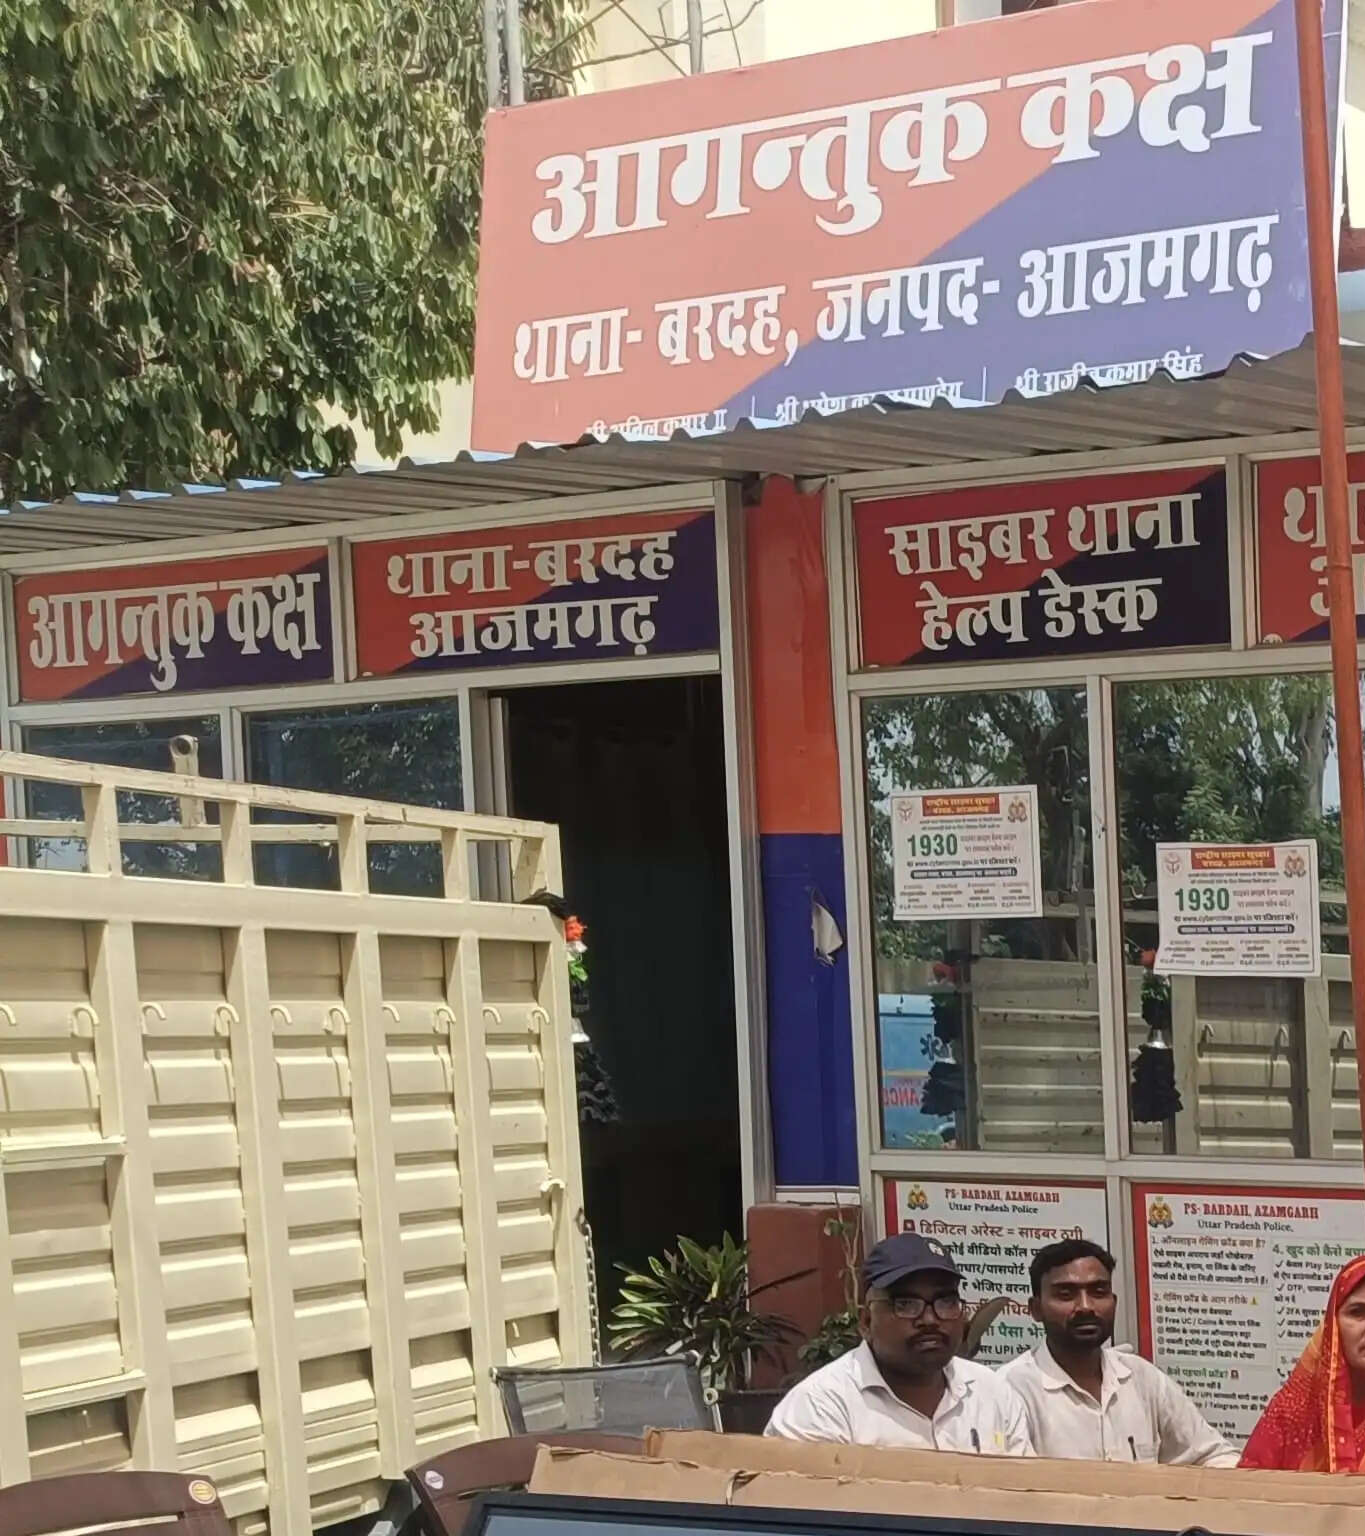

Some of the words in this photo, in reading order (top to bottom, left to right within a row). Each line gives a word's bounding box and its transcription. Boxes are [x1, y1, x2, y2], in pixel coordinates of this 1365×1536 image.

[530, 77, 1002, 243] आगन्तुक
[1004, 29, 1274, 166] कक्ष
[655, 283, 799, 368] बरदह,
[1016, 212, 1280, 321] आजमगढ़
[884, 508, 1056, 581] साइबर
[1067, 492, 1202, 555] थाना
[27, 581, 220, 692] आगन्तुक
[220, 571, 322, 660] कक्ष
[409, 596, 659, 659] आजमगढ़
[915, 578, 1039, 652] हेल्प
[1040, 568, 1163, 641] डेस्क
[907, 833, 958, 857] 1930
[1174, 887, 1229, 912] 1930
[920, 1219, 967, 1237] डिजिटल
[970, 1221, 1004, 1237] अरेस्ट
[1018, 1226, 1057, 1240] साइबर
[948, 1202, 971, 1212] Uttar
[974, 1203, 1010, 1213] Pradesh
[1012, 1204, 1039, 1214] Police
[1198, 1220, 1222, 1229] Uttar
[1224, 1220, 1261, 1231] Pradesh
[967, 1241, 1002, 1258] वीडियो
